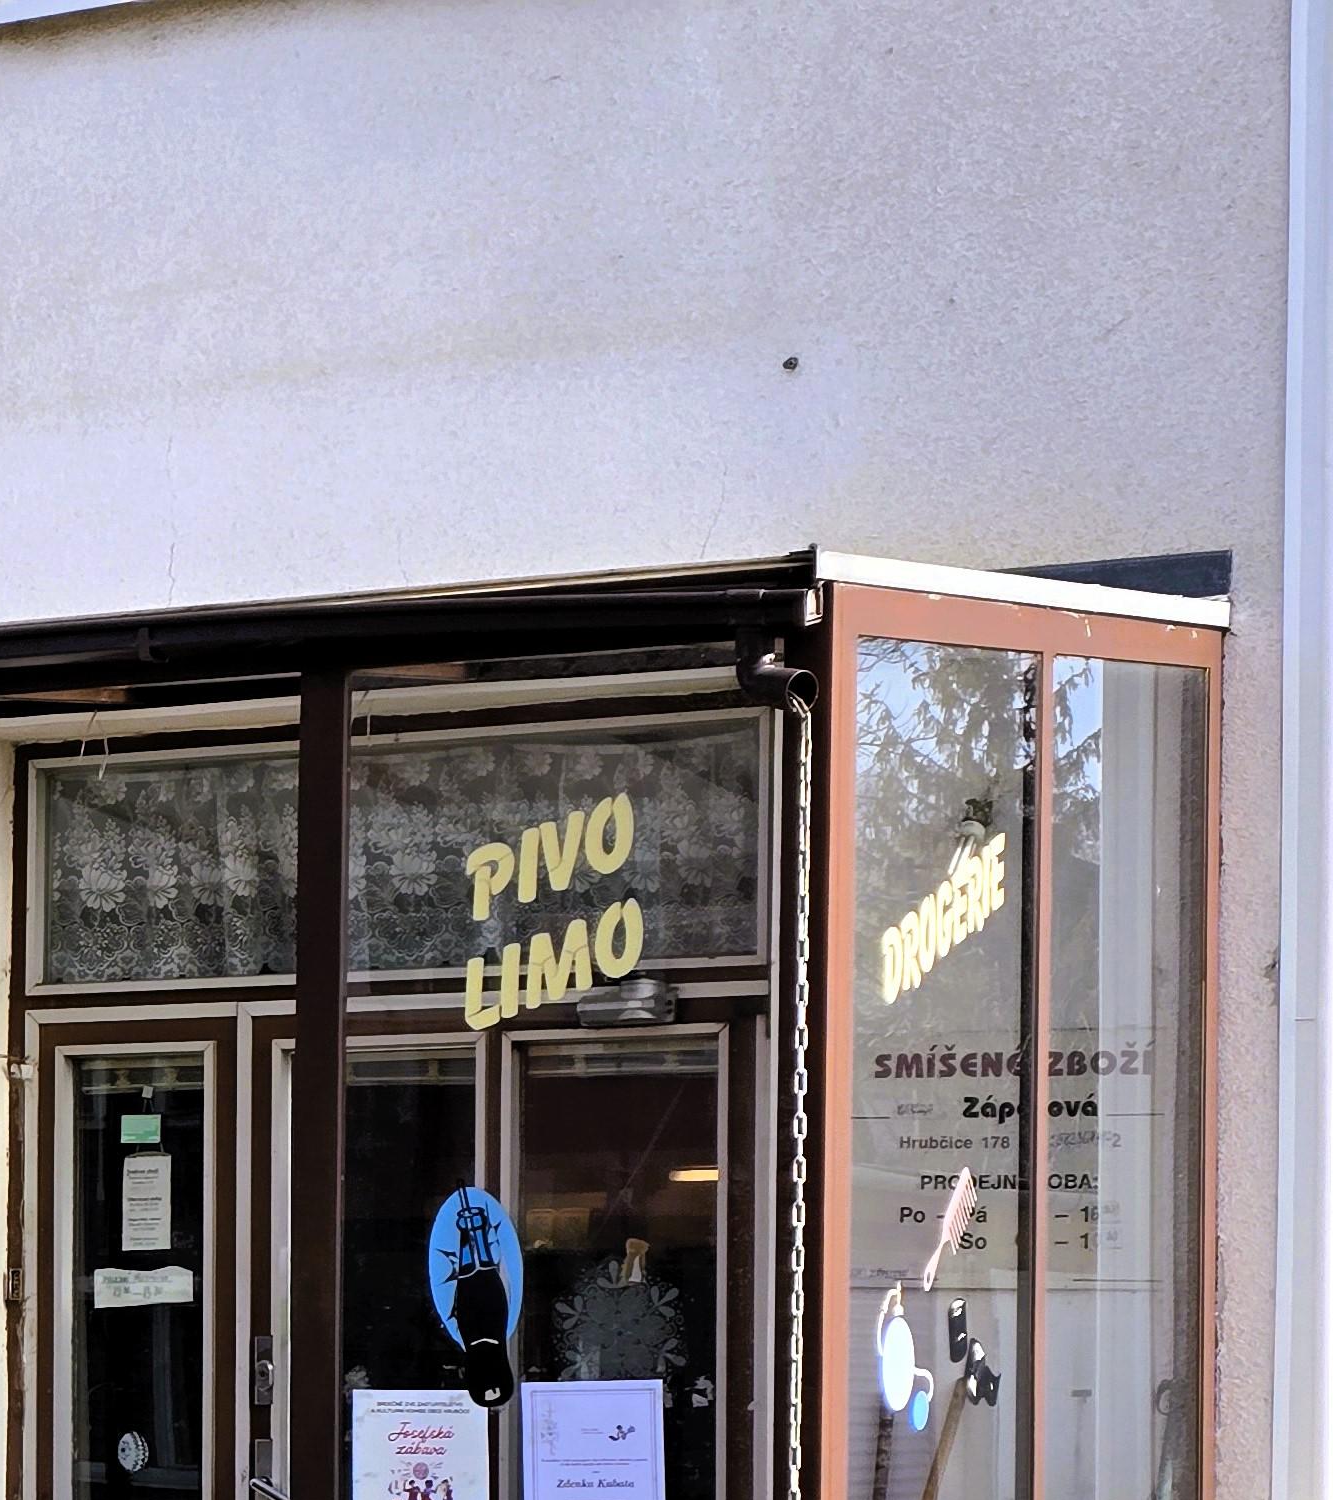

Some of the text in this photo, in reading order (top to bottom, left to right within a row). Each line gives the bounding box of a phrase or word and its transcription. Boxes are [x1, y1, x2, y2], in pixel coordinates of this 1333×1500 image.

[466, 793, 633, 921] PIVO
[882, 832, 1006, 1004] DROGERIE
[465, 898, 643, 1030] LIMO
[1047, 1040, 1156, 1077] ZBOŽÍ
[962, 1093, 1098, 1124] Zápová
[899, 1135, 1011, 1150] Hrubčice 178
[1046, 1173, 1098, 1191] OBA:
[899, 1207, 926, 1224] Po
[960, 1234, 988, 1250] So
[388, 1421, 455, 1443] Josefská
[395, 1440, 447, 1456] zábava
